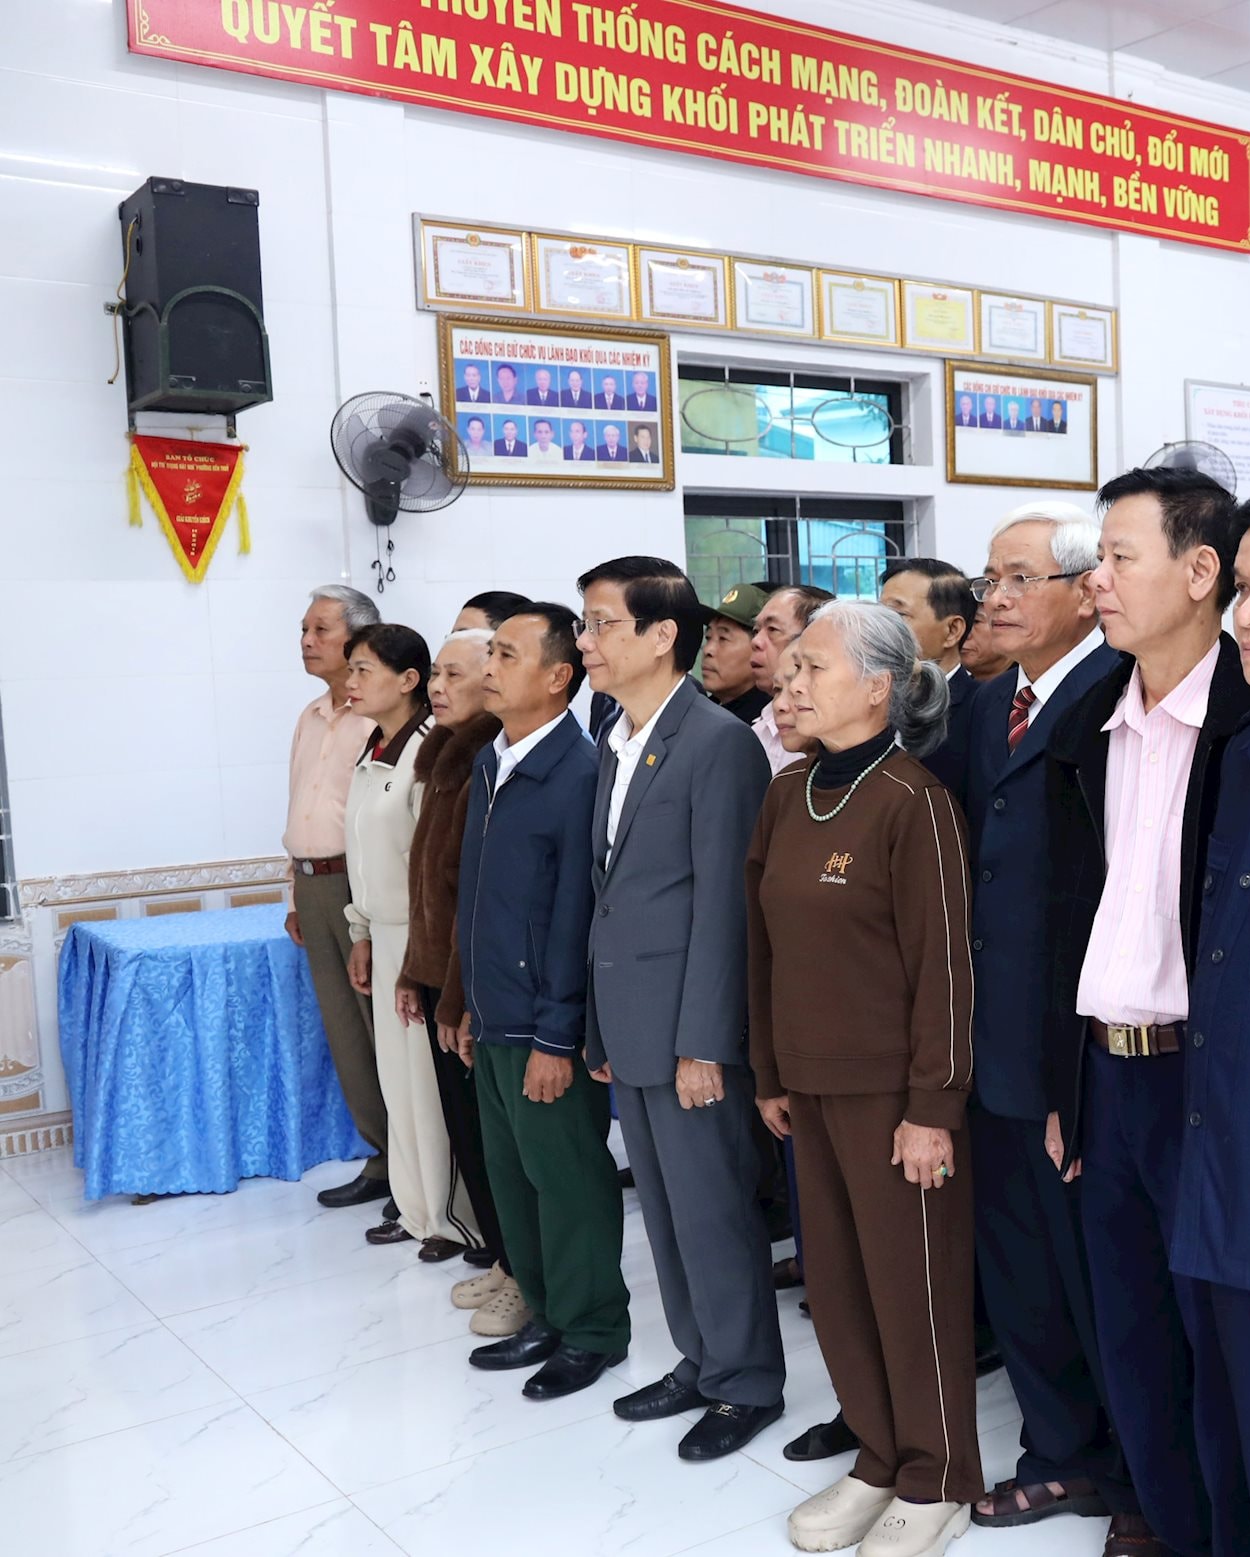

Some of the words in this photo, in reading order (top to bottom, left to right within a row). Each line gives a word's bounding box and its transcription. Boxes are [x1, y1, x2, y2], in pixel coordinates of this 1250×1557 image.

[221, 0, 358, 60] QUYẾT
[369, 20, 458, 80] TÂM
[469, 41, 544, 96] XÂY
[555, 61, 652, 118] DỰNG
[662, 83, 739, 135] KHỐI
[748, 104, 826, 151] PHÁT
[834, 116, 916, 168] TRIỂN
[924, 137, 1022, 192] NHANH,
[1028, 159, 1107, 209] MẠNH,
[1113, 171, 1158, 215] BỀN
[1162, 185, 1220, 227] VỮNG
[421, 0, 562, 37] UYỀN
[572, 3, 687, 64] THỐNG
[697, 31, 781, 85] CÁCH
[791, 53, 888, 112] MẠNG,
[895, 78, 969, 125] ĐOÀN
[976, 91, 1027, 142] KẾT,
[1032, 106, 1083, 150] DÂN
[1089, 119, 1142, 166] CHỦ,
[1147, 128, 1184, 172] ĐỔI
[1190, 144, 1230, 182] MỚI
[182, 453, 193, 462] TỔ
